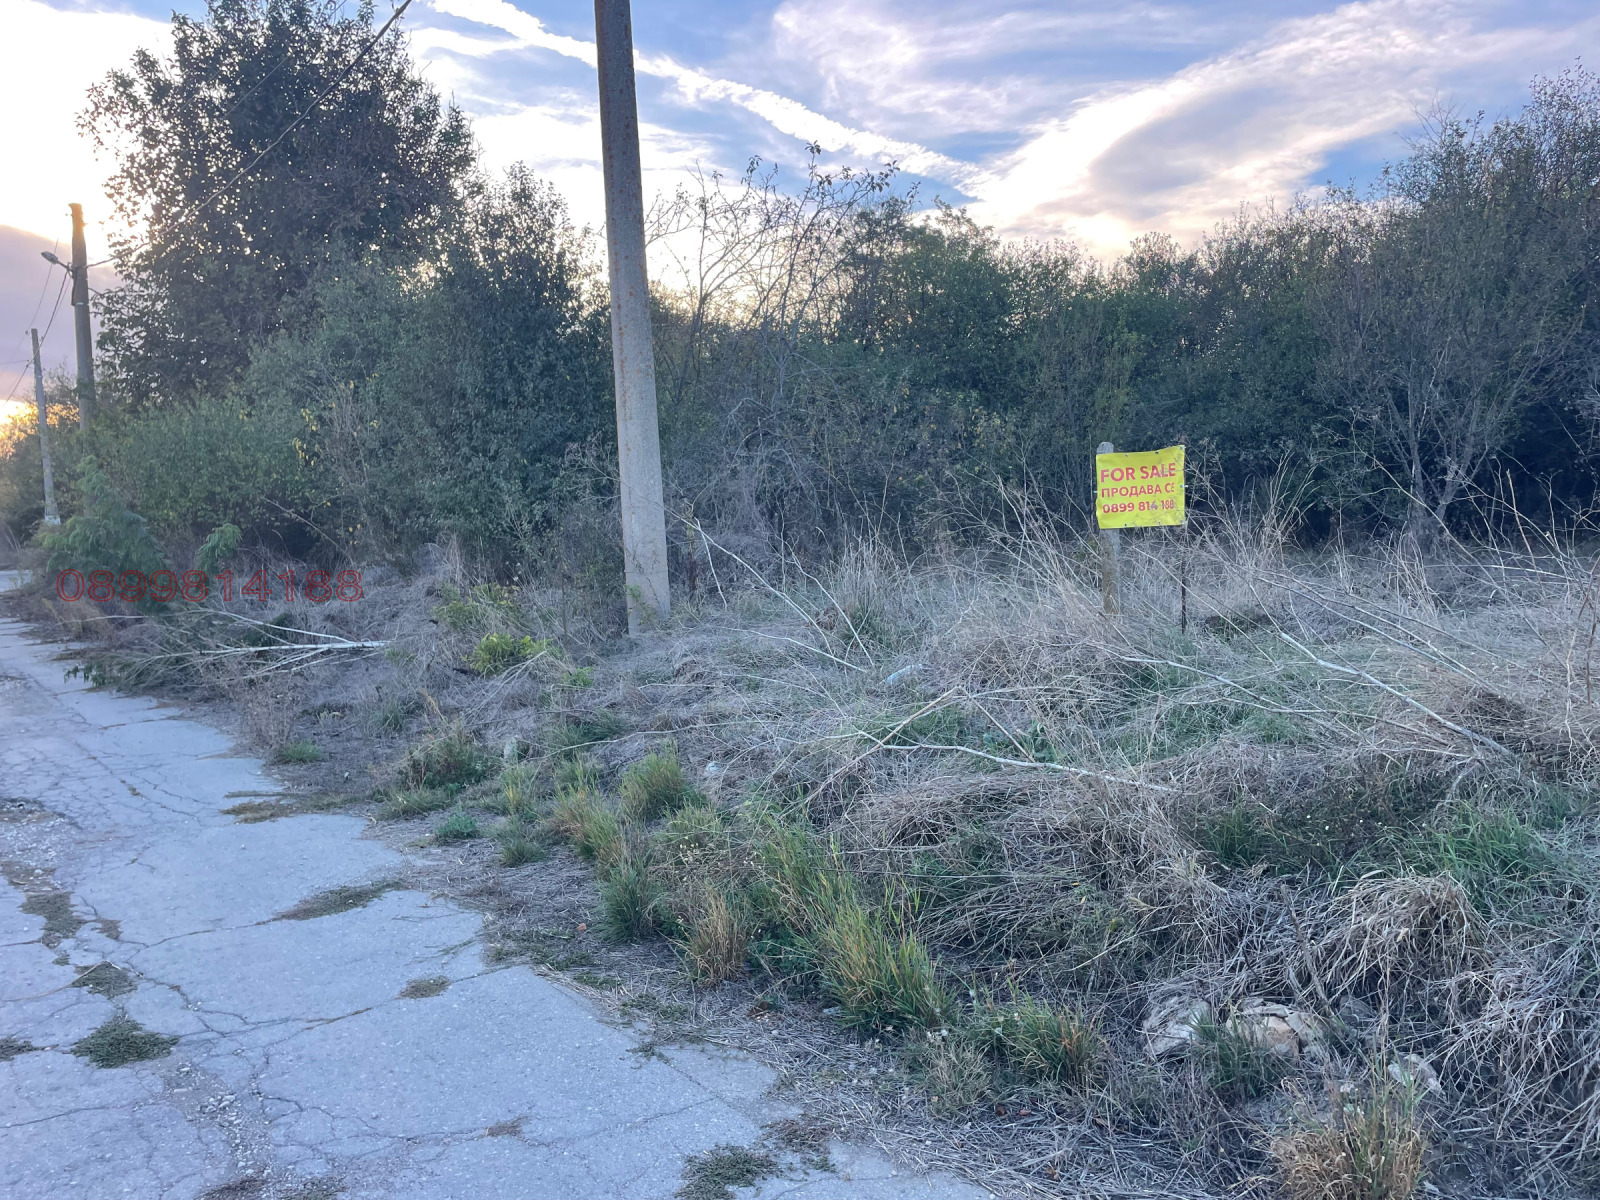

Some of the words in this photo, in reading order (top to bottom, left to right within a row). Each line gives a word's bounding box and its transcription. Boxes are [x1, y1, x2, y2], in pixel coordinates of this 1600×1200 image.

[1100, 467, 1136, 482] FOR
[1139, 463, 1176, 479] SALE
[1101, 484, 1162, 498] ПРОДАВА
[1164, 482, 1175, 493] СЕ
[1102, 502, 1135, 513] 0899
[1138, 500, 1158, 511] 814
[1160, 499, 1175, 510] 188
